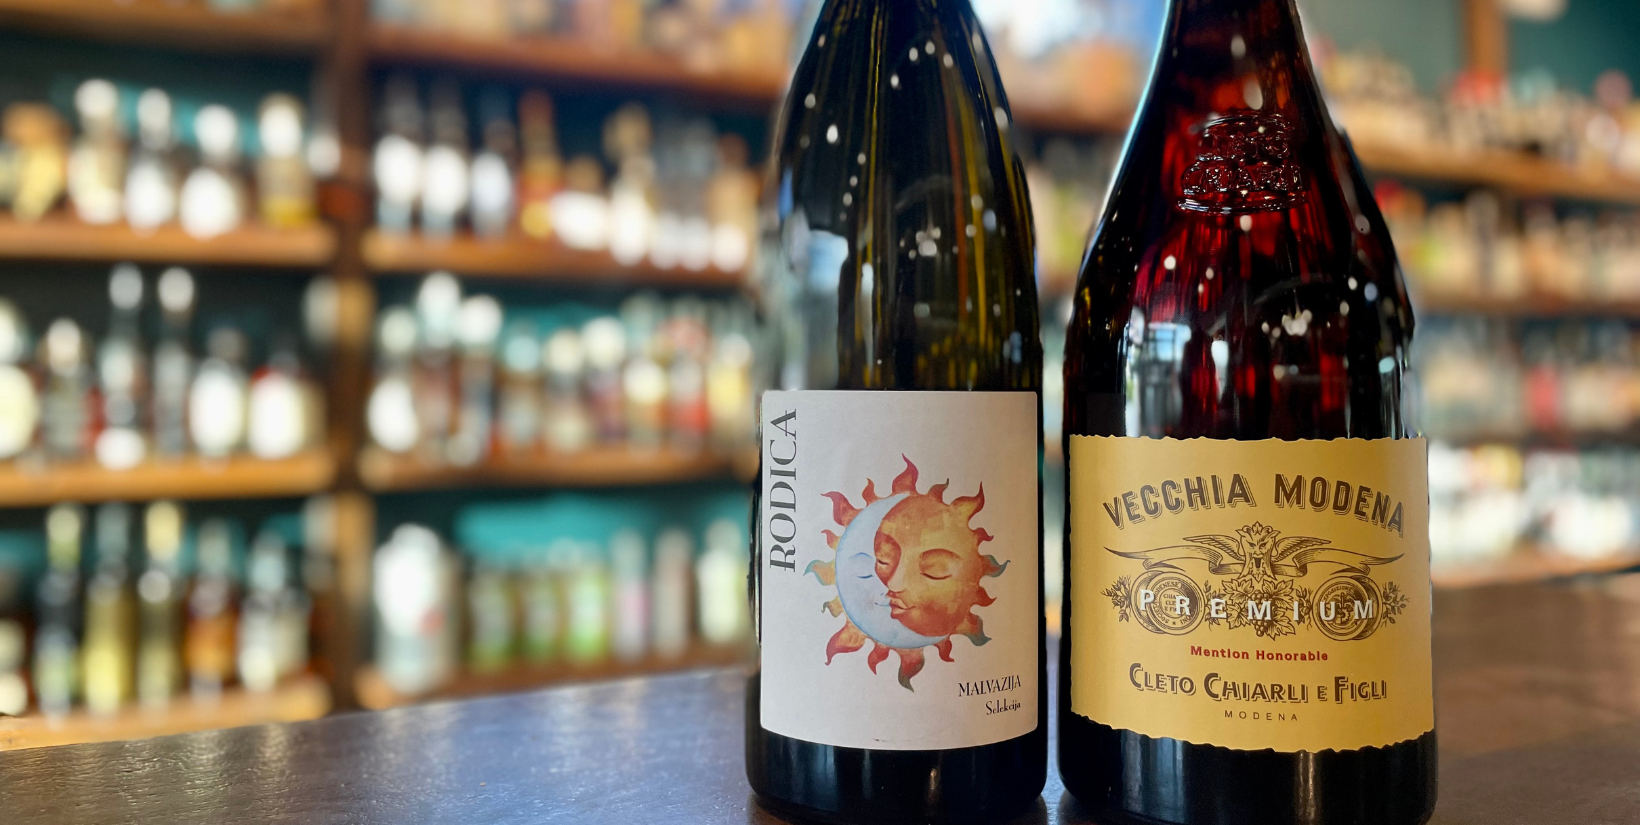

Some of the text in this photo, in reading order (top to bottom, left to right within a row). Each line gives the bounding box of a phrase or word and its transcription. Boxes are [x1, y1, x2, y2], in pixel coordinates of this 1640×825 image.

[769, 408, 797, 573] RODICA
[1103, 474, 1405, 538] VECCHIA MODENA
[1140, 589, 1373, 621] PREMIUM
[1190, 645, 1328, 661] Mention Honorable
[957, 674, 1021, 697] MALVAZIJA
[1129, 662, 1196, 696] CLETO
[1204, 672, 1308, 704] CHIARLI
[1334, 676, 1387, 704] FIGLI
[985, 698, 1021, 716] Selekcija
[1224, 709, 1298, 722] MODENA
